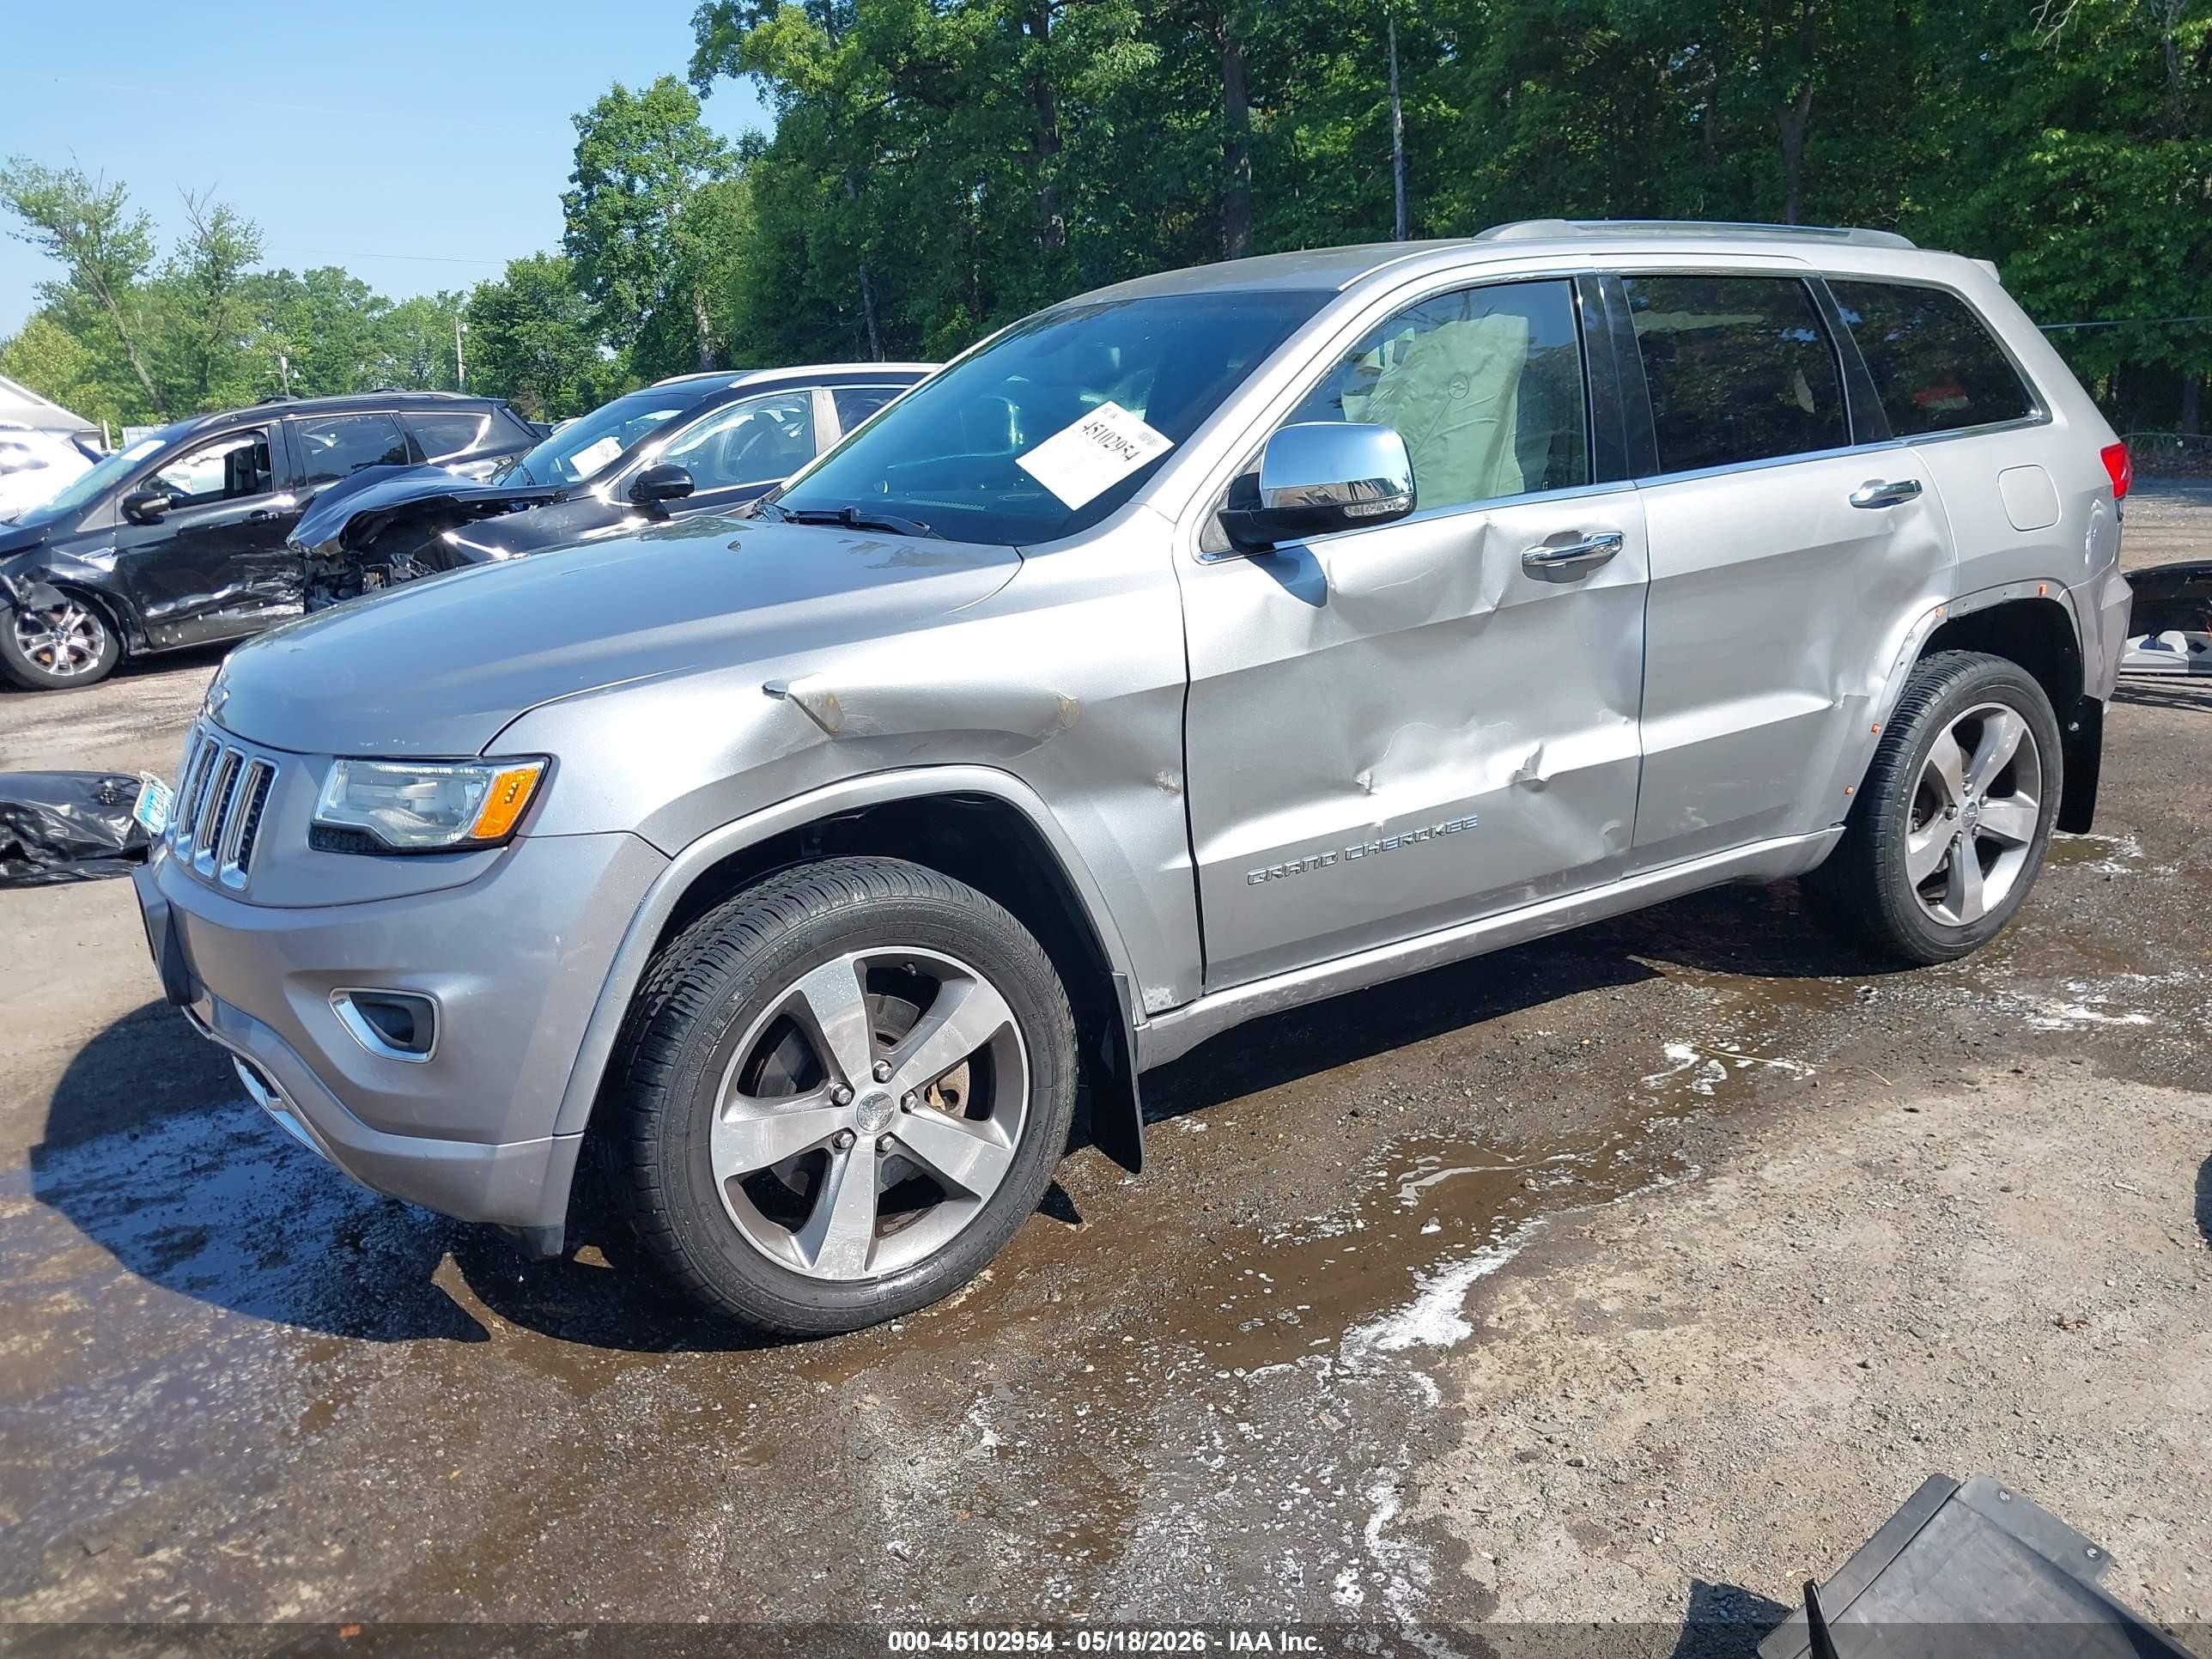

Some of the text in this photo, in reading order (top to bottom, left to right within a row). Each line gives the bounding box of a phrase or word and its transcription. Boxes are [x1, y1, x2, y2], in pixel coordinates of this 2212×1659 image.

[1082, 421, 1141, 462] 45102954
[1247, 815, 1478, 886] GRAND CHEROKEE
